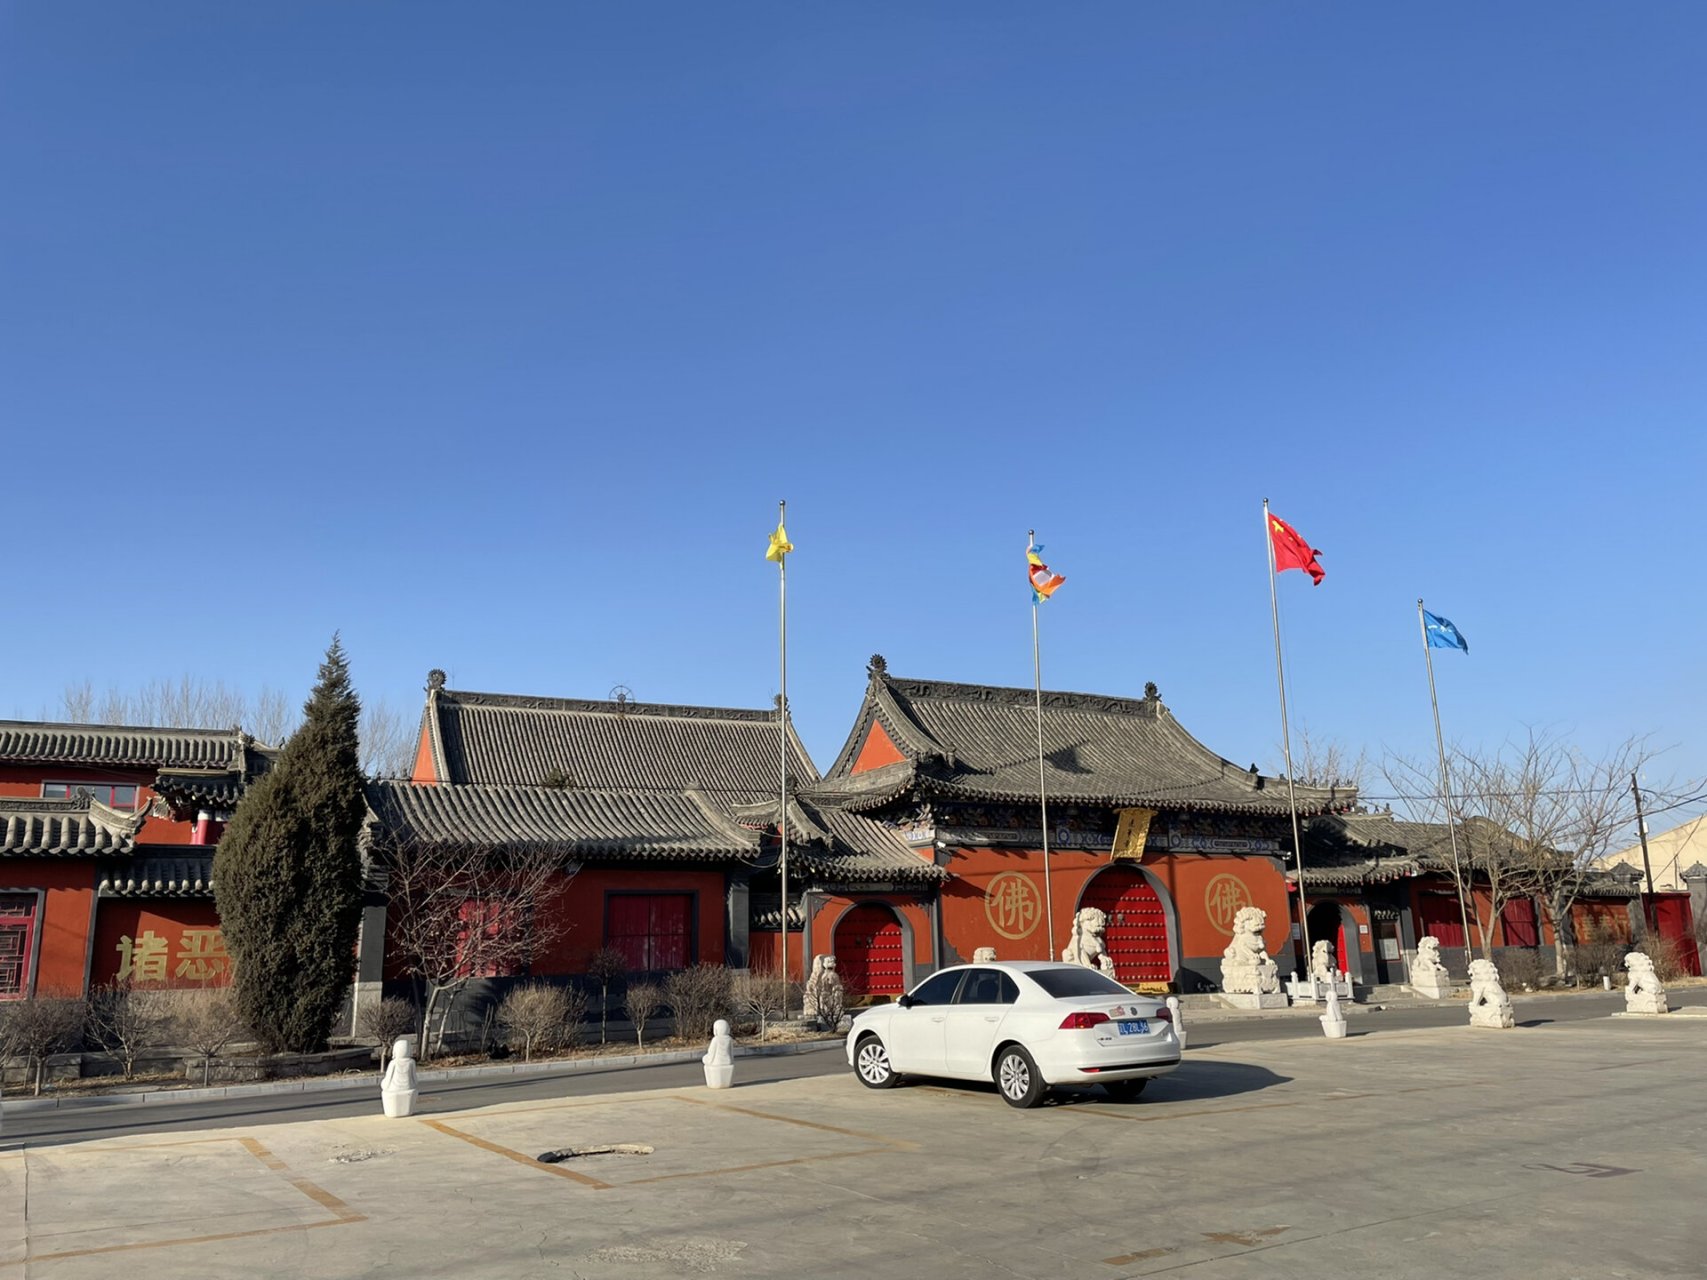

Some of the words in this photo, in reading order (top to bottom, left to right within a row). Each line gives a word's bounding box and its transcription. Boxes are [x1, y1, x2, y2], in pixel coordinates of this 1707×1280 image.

[990, 877, 1035, 932] 佛
[1209, 880, 1247, 928] 佛
[115, 930, 229, 982] 诸恶
